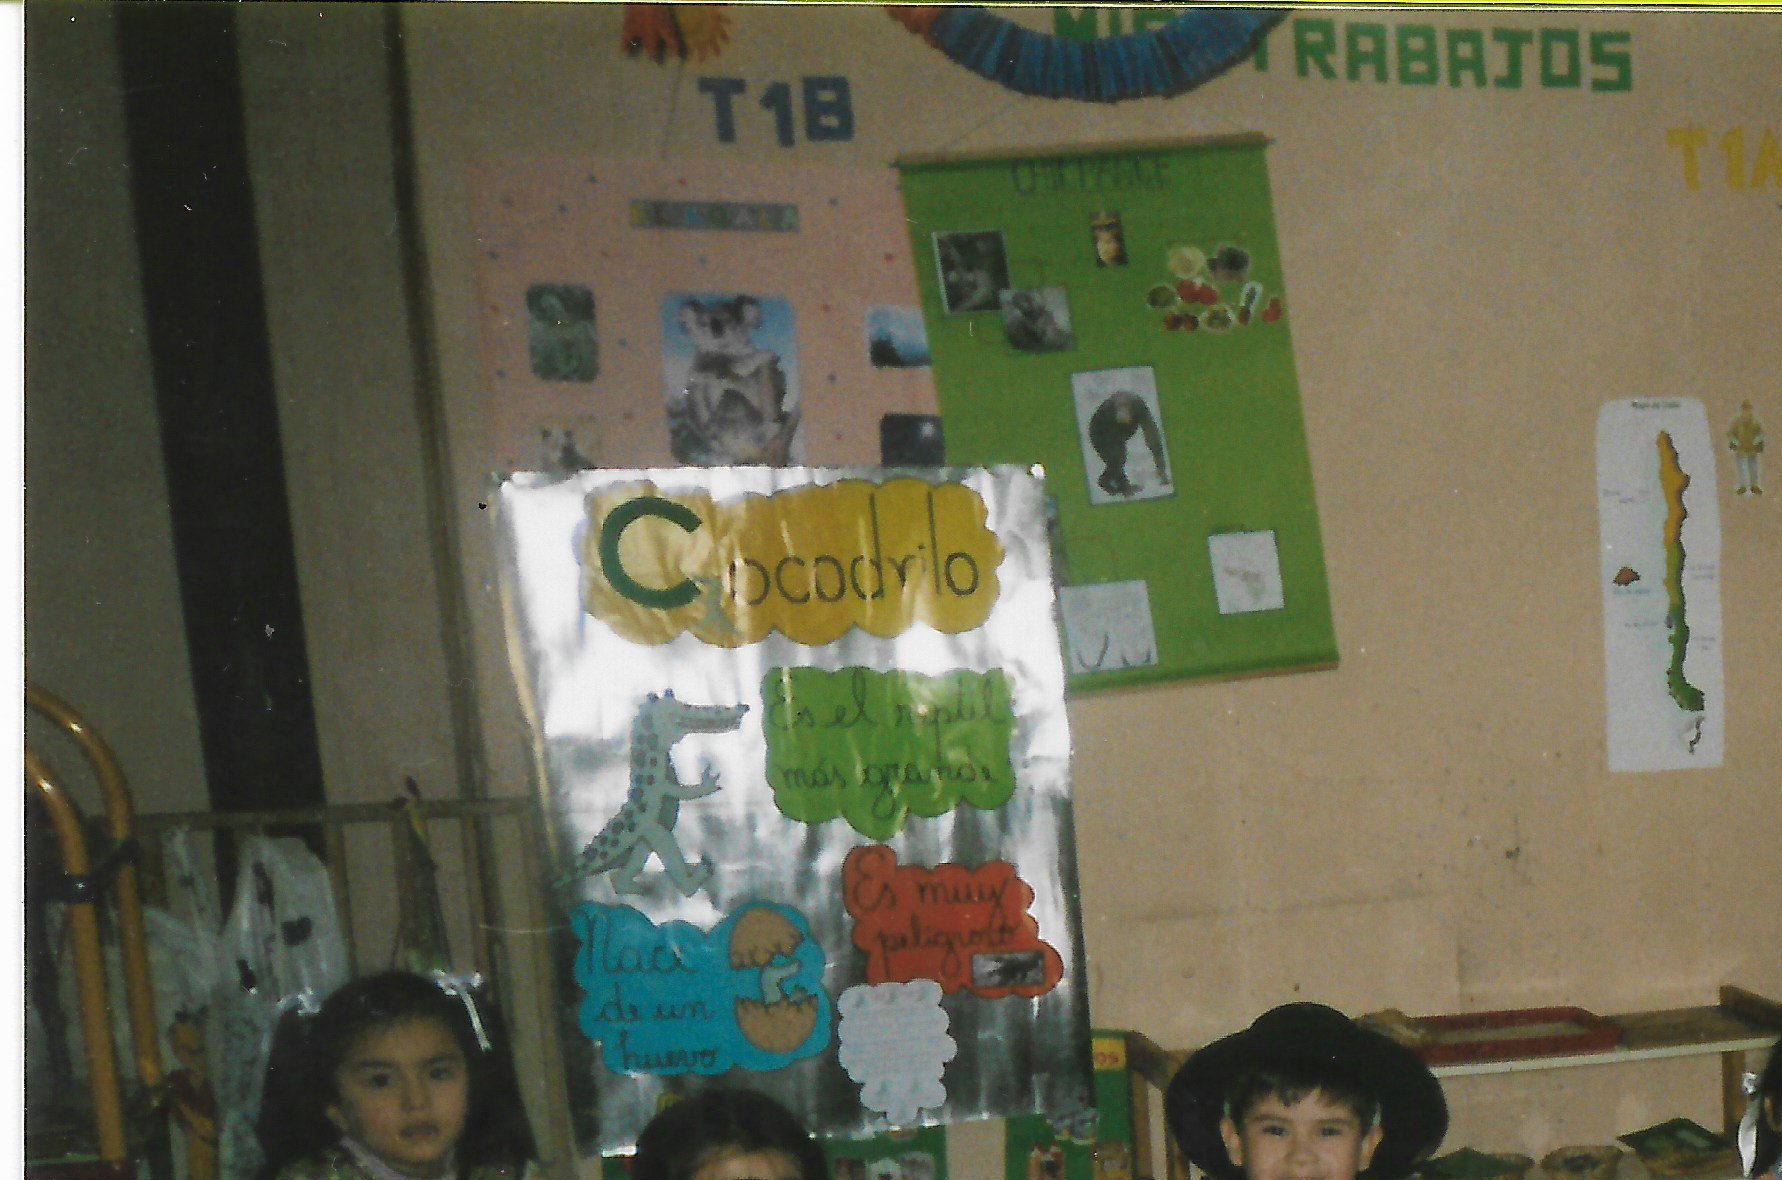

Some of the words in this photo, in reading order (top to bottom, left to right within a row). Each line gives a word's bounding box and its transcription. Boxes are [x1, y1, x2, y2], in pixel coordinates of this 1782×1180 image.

[697, 75, 854, 148] T1B
[599, 492, 980, 609] Cocodrilo
[821, 667, 881, 728] el
[774, 758, 848, 790] más
[855, 851, 898, 913] Es
[916, 878, 1013, 934] muy
[593, 981, 643, 1024] de
[655, 997, 718, 1021] un
[619, 1027, 721, 1072] huevo
